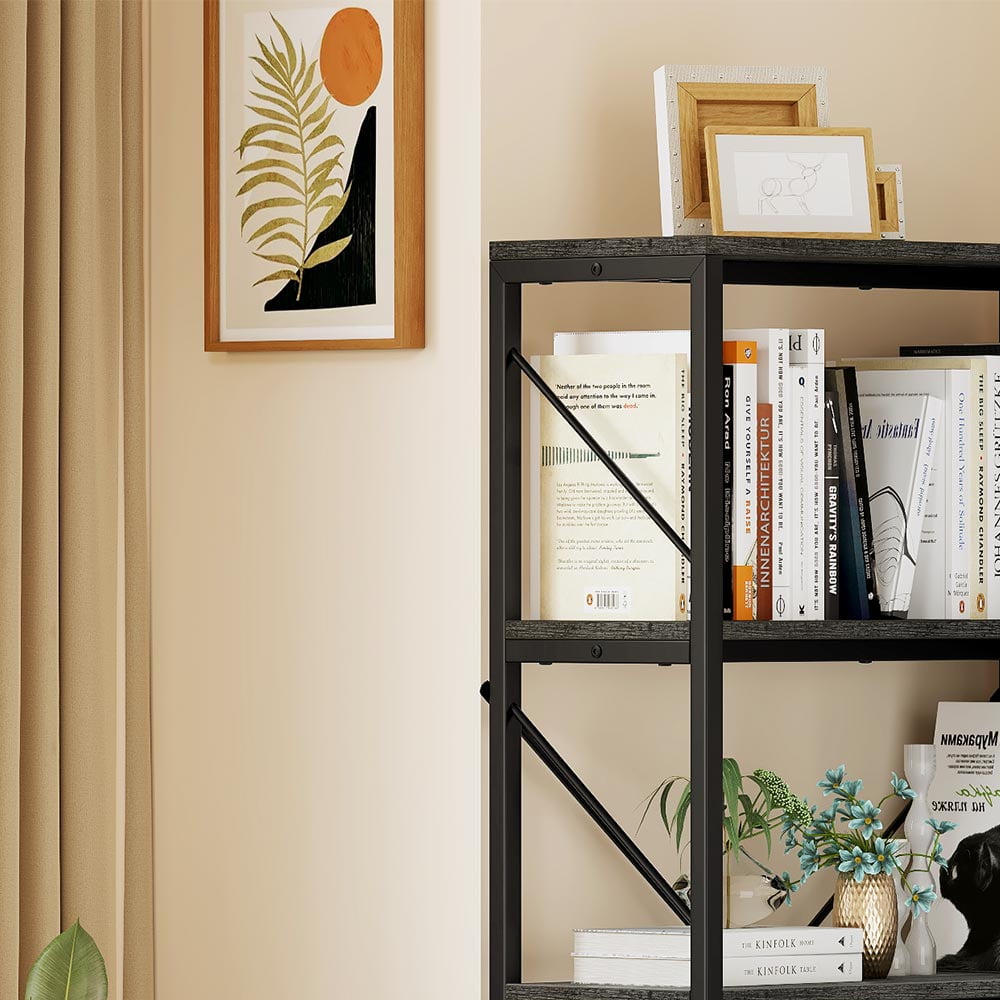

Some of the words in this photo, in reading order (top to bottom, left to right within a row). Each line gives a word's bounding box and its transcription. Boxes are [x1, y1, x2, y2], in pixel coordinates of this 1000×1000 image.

[745, 488, 751, 496] A
[760, 417, 771, 588] INNENARCHITEKTUR
[828, 486, 838, 541] GRAVITY'S
[828, 544, 838, 595] RAINBOW
[755, 938, 797, 950] KINFOLK
[757, 965, 797, 976] KINFOLK
